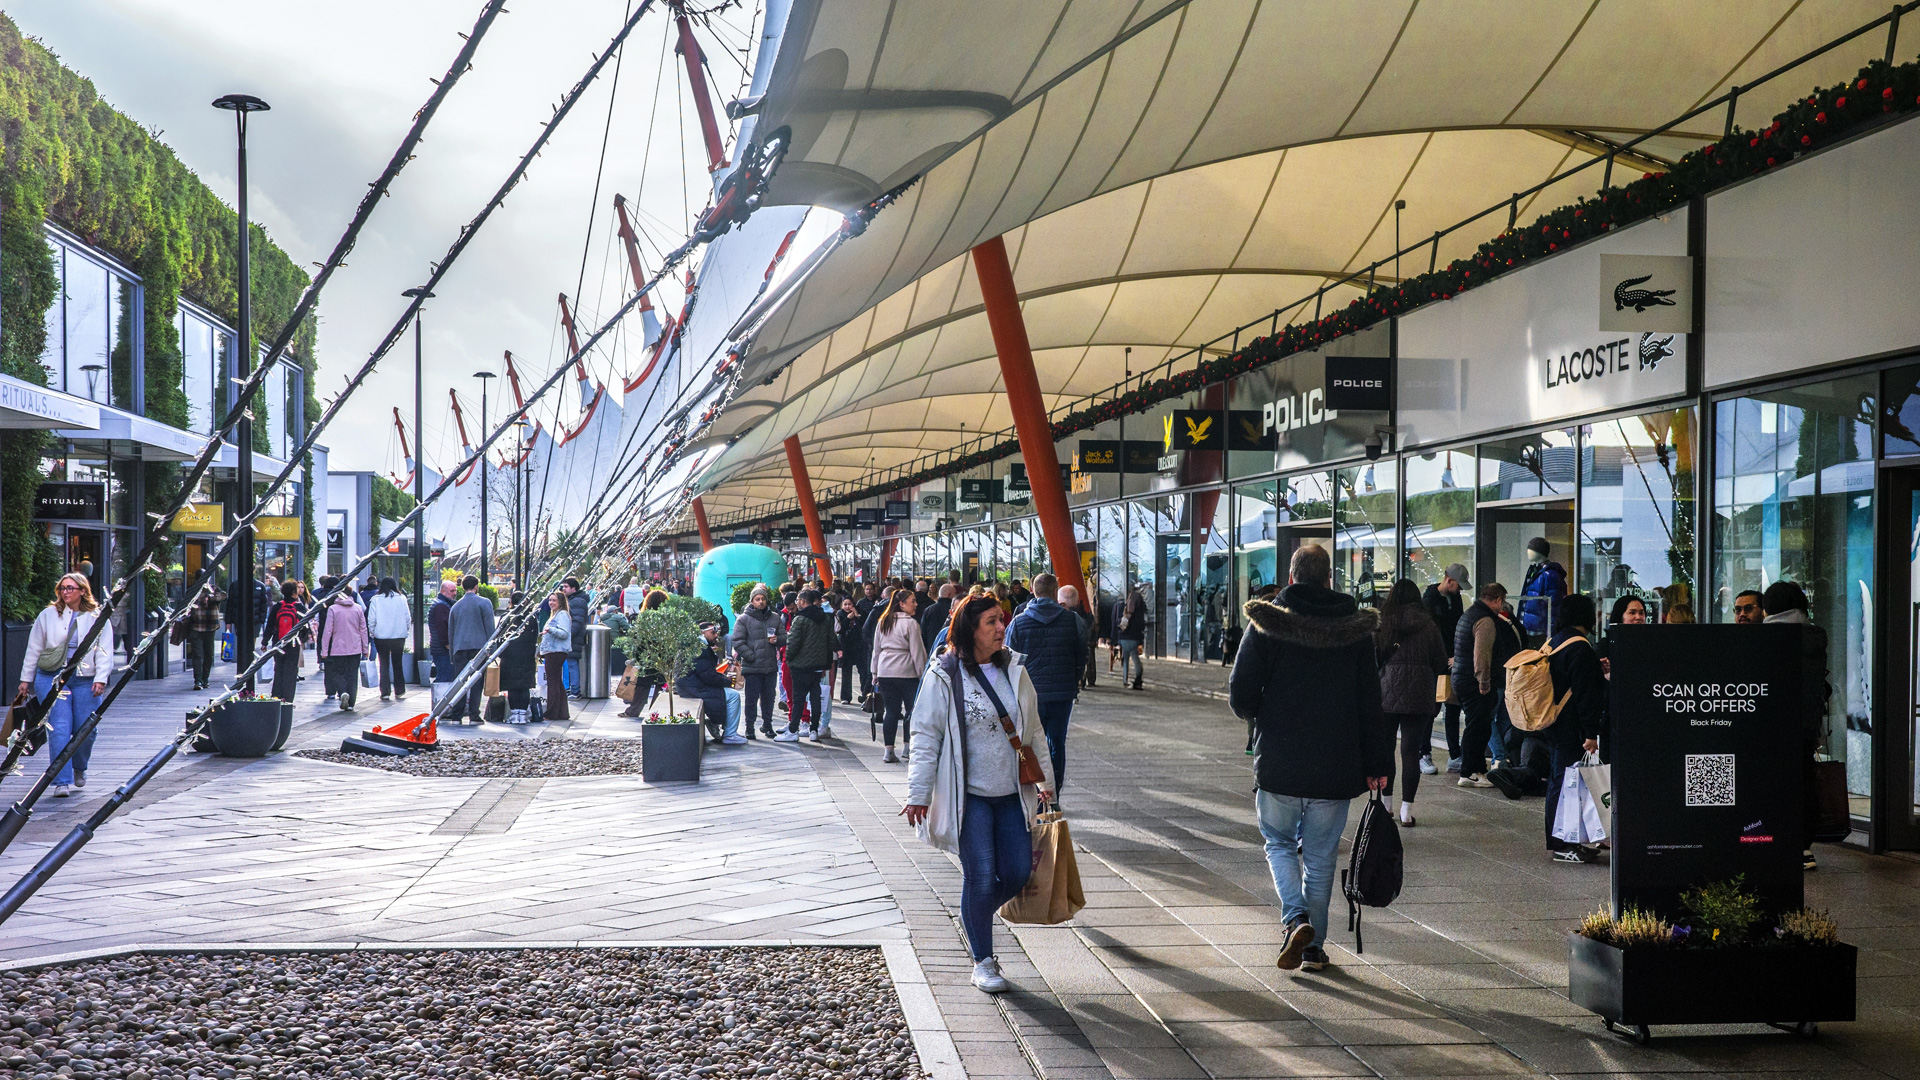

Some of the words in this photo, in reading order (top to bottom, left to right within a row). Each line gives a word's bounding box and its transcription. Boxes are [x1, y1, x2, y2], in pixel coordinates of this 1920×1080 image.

[1547, 338, 1630, 389] LACOSTE
[1333, 379, 1383, 388] POLICE
[2, 384, 60, 418] RITUALS...
[1085, 450, 1102, 458] Jack
[42, 498, 97, 506] RITUALS...
[1616, 587, 1634, 599] BLACK
[1652, 683, 1694, 697] SCAN
[1698, 683, 1721, 697] QR
[1724, 683, 1769, 697] CODE
[1665, 699, 1696, 713] FOR
[1700, 699, 1756, 713] OFFERS
[1710, 719, 1732, 727] Friday
[1743, 820, 1762, 832] Ashford
